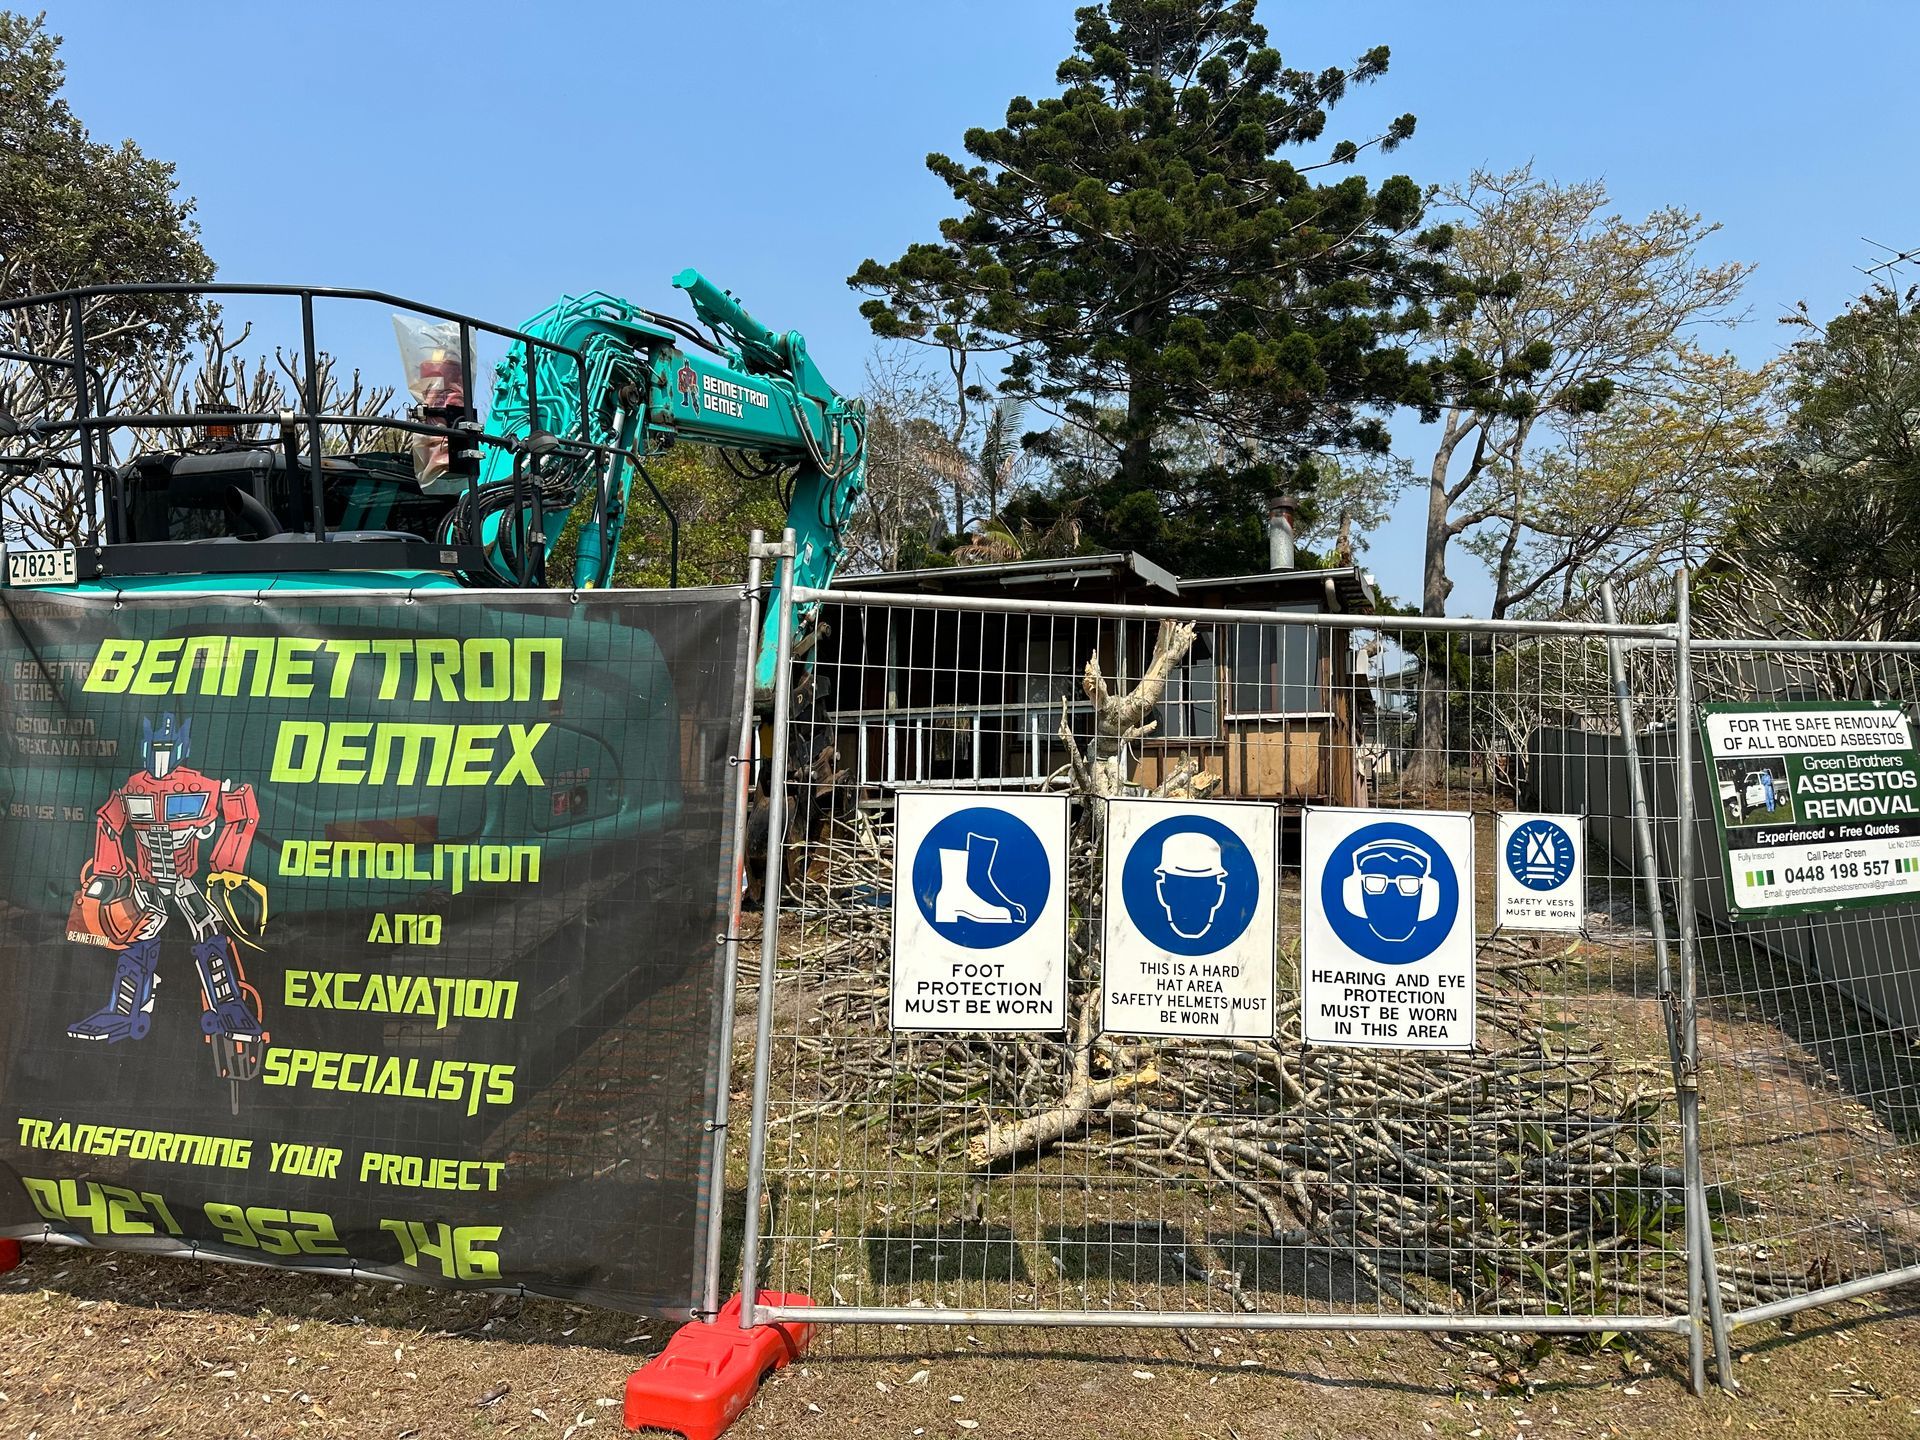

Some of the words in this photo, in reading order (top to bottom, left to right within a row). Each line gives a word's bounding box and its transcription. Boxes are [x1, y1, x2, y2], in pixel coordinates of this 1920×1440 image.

[702, 374, 769, 409] BENNETTRON
[703, 393, 744, 419] DEMEX
[82, 636, 563, 702] BENNETTRON
[1729, 719, 1759, 733] FOR
[1763, 718, 1792, 732] THE
[1795, 717, 1829, 731] SAFE
[1835, 716, 1897, 730] REMOVAL
[1724, 737, 1743, 750] OF
[1748, 736, 1774, 750] ALL
[1778, 735, 1836, 749] BONDED
[1840, 732, 1904, 746] ASBESTOS
[270, 720, 552, 787] DEMEX
[1803, 756, 1846, 770] Green
[1849, 754, 1903, 769] Brothers
[1796, 770, 1917, 795] ASBESTOS
[1804, 795, 1919, 820] REMOVAL
[1757, 828, 1825, 846] Experienced
[1839, 825, 1863, 838] Free
[1864, 823, 1900, 838] Quotes
[1738, 853, 1751, 862] Fully
[1752, 851, 1775, 860] Insured
[1807, 851, 1821, 862] Call
[1822, 850, 1843, 861] Peter
[1845, 848, 1867, 859] Green
[278, 840, 541, 895] DEMOLITION
[1785, 865, 1825, 884] 0448
[1830, 862, 1858, 880] 198
[1863, 859, 1890, 877] 557
[367, 913, 442, 945] AND
[67, 931, 110, 947] BENNETTRON
[952, 964, 1005, 978] FOOT
[1140, 962, 1169, 975] THIS
[1173, 963, 1185, 976] IS
[1189, 964, 1198, 976] A
[1202, 965, 1240, 978] HARD
[1312, 970, 1386, 986] HEARING
[1395, 973, 1430, 987] AND
[1438, 975, 1465, 988] EYE
[917, 981, 1042, 996] PROTECTION
[1157, 979, 1183, 992] HAT
[1186, 980, 1223, 993] AREA
[284, 970, 519, 1030] EXCAVATION
[1111, 992, 1163, 1007] SAFETY
[1167, 995, 1228, 1009] HELMETS
[1232, 997, 1267, 1010] MUST
[1344, 988, 1445, 1005] PROTECTION
[905, 999, 960, 1014] MUST
[966, 1000, 991, 1014] BE
[996, 1000, 1053, 1014] WORN
[1321, 1004, 1370, 1019] MUST
[1379, 1007, 1399, 1020] BE
[1409, 1008, 1457, 1021] WORN
[1160, 1010, 1177, 1023] BE
[1181, 1012, 1219, 1025] WORN
[1335, 1021, 1351, 1035] IN
[1361, 1023, 1398, 1036] THIS
[1407, 1024, 1449, 1038] AREA
[262, 1047, 517, 1117] SPECIALISTS
[18, 1117, 253, 1170] TRANSFORMING
[269, 1142, 343, 1180] YOUR
[360, 1152, 505, 1192] PROJECT
[21, 1177, 184, 1235] 0421
[203, 1202, 350, 1256] 952
[379, 1218, 504, 1281] 746
